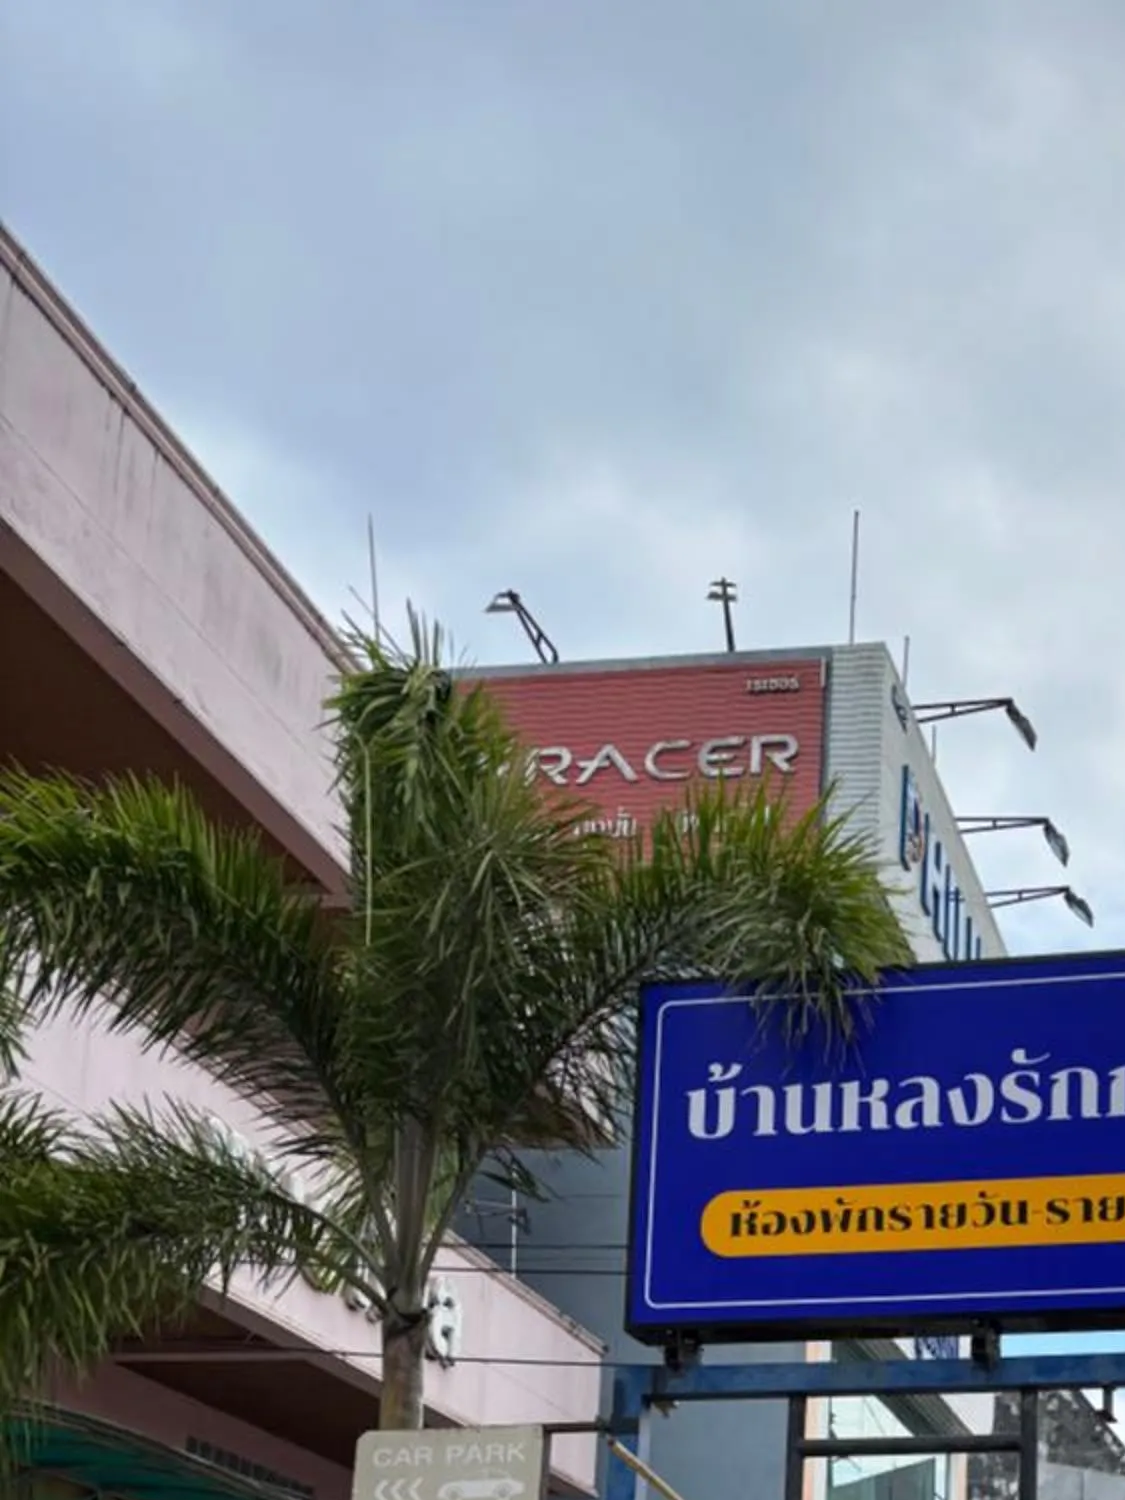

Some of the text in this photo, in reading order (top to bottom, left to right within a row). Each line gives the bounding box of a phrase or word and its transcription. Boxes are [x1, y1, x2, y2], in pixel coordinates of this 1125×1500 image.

[523, 734, 799, 786] RACER
[373, 1442, 526, 1468] CAR PARK
